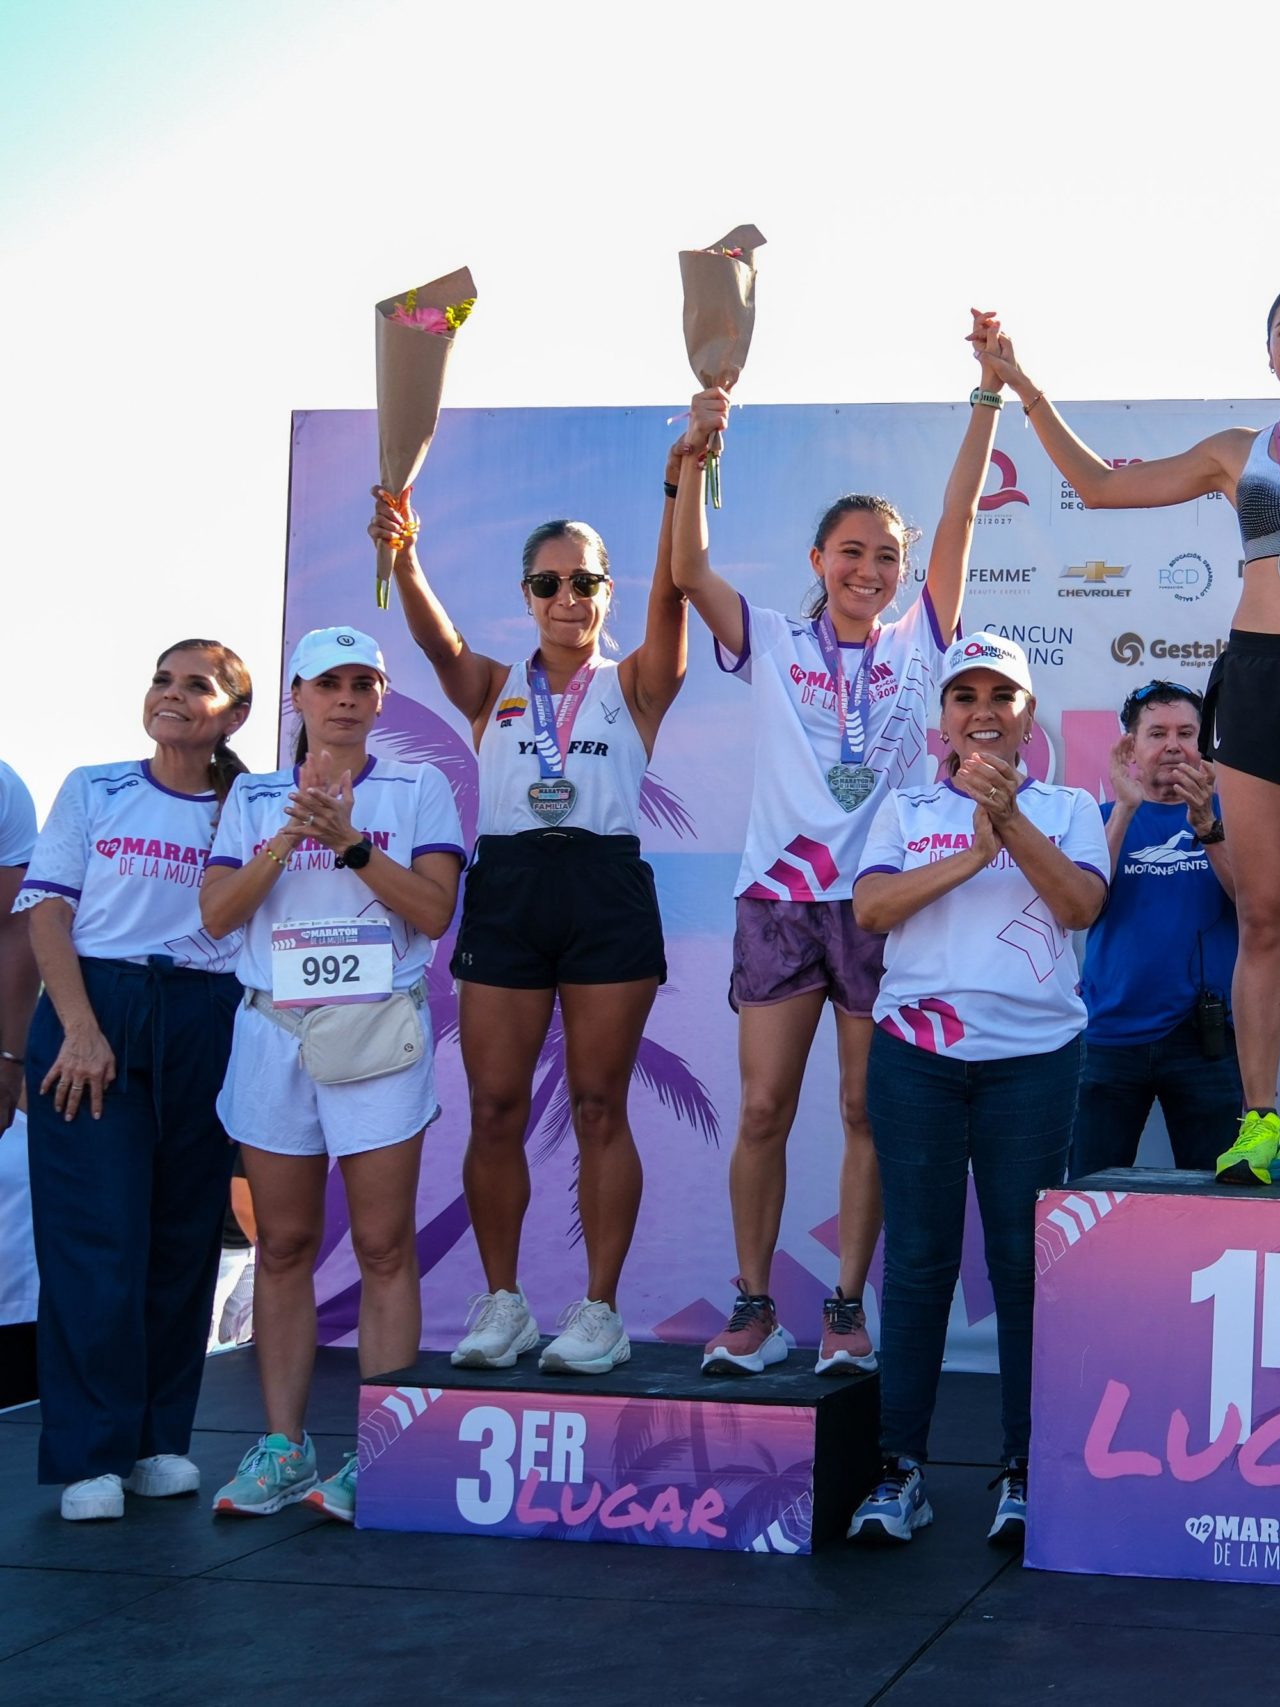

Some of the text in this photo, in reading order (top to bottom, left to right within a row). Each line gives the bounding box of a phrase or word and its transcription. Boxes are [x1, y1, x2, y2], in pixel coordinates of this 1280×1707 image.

[1061, 502, 1074, 510] DE
[914, 569, 1031, 582] UFEMME
[1159, 569, 1199, 584] RCD
[1058, 589, 1132, 598] CHEVROLET
[983, 624, 1073, 645] CANCUN
[981, 652, 1003, 660] ROO
[801, 686, 837, 712] DE LA
[518, 741, 609, 756] YFER
[121, 837, 211, 867] MARAT
[119, 856, 206, 888] DE LA MUJE
[302, 954, 360, 986] 992
[456, 1406, 587, 1525] 3ER
[516, 1468, 727, 1538] LUGAR
[1213, 1542, 1231, 1567] DE
[1240, 1544, 1258, 1568] LA
